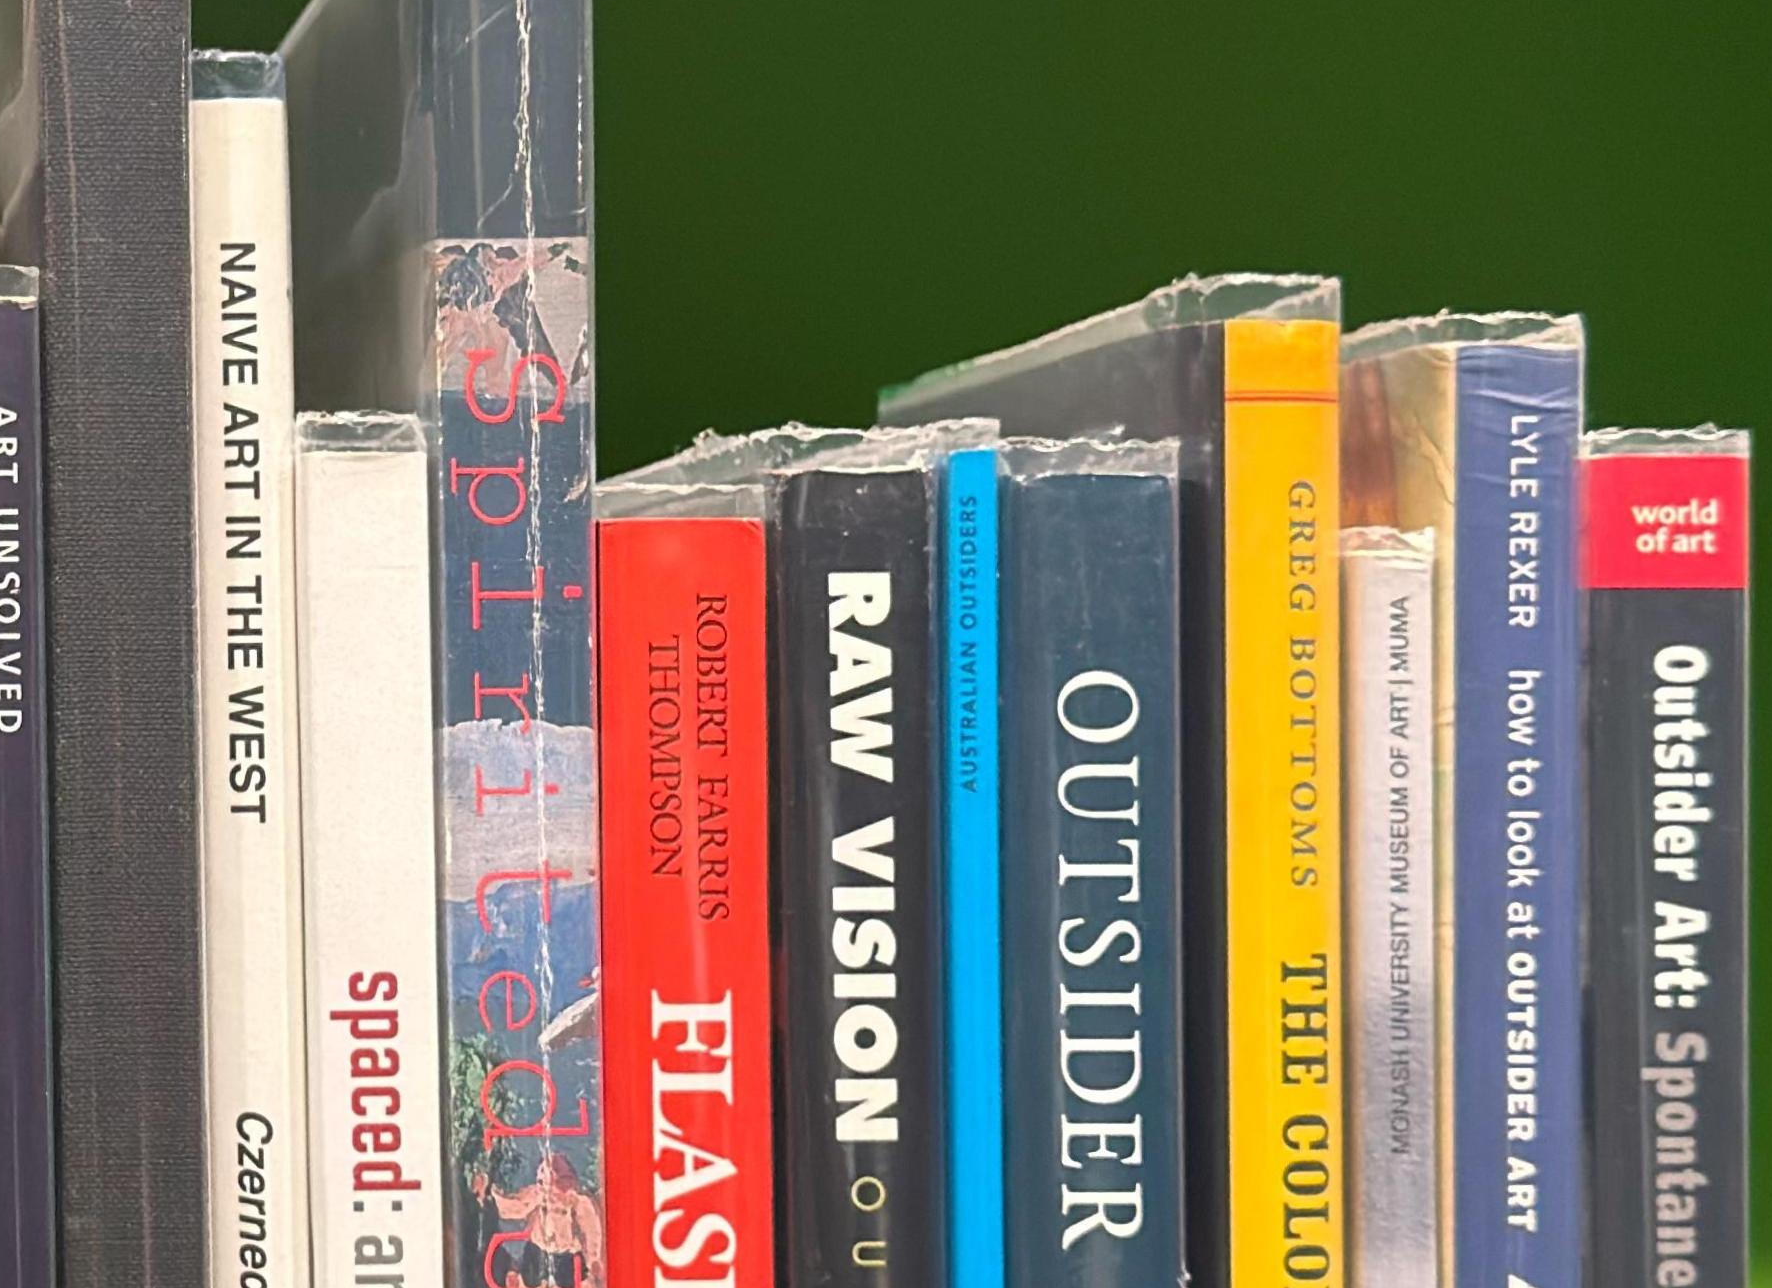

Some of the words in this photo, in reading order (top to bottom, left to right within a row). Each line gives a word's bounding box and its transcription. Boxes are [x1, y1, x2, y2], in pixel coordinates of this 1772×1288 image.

[219, 241, 258, 387] NAIVE
[222, 403, 260, 499] ART
[1512, 414, 1542, 497] LYLE
[1631, 498, 1718, 525] world
[224, 516, 261, 561] IN
[959, 495, 978, 630] OUTSIDERS
[1509, 511, 1539, 628] REXER
[1636, 525, 1668, 553] of
[1672, 528, 1716, 553] art
[226, 577, 262, 670] THE
[828, 572, 894, 782] RAW
[227, 686, 265, 823] WEST
[450, 348, 590, 1151] Spirited
[959, 642, 978, 794] AUSTRALIAN
[1653, 644, 1712, 879] Outsider
[831, 819, 897, 1143] VISION
[1056, 670, 1140, 1249] OUTSIDER
[1280, 955, 1329, 1085] THE
[1654, 902, 1709, 1008] Art:
[330, 970, 421, 1213] spaced:
